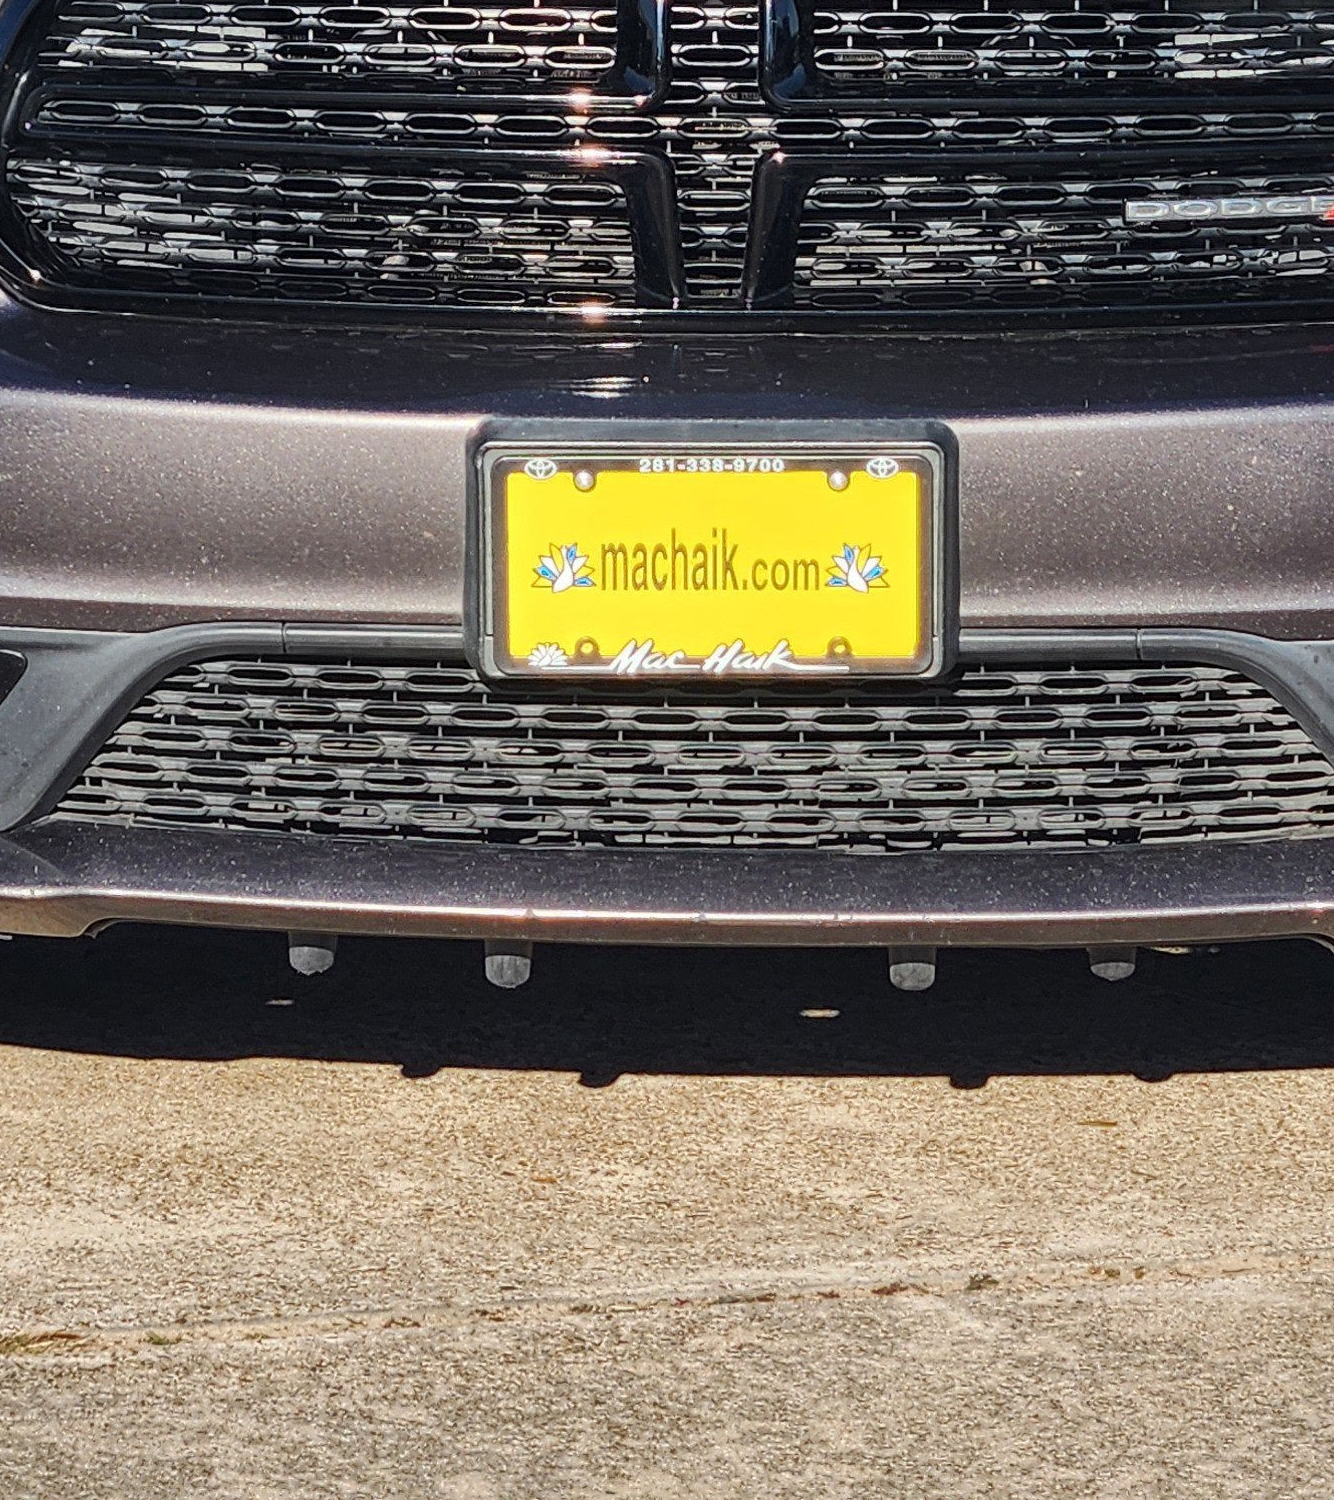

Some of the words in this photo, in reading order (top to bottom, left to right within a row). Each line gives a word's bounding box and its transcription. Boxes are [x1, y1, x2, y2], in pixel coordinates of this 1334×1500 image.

[1126, 198, 1331, 220] DODGE
[639, 457, 785, 473] 281-338-9700
[601, 527, 820, 591] machaik.com
[609, 638, 700, 675] Mac
[702, 638, 802, 675] Haik
